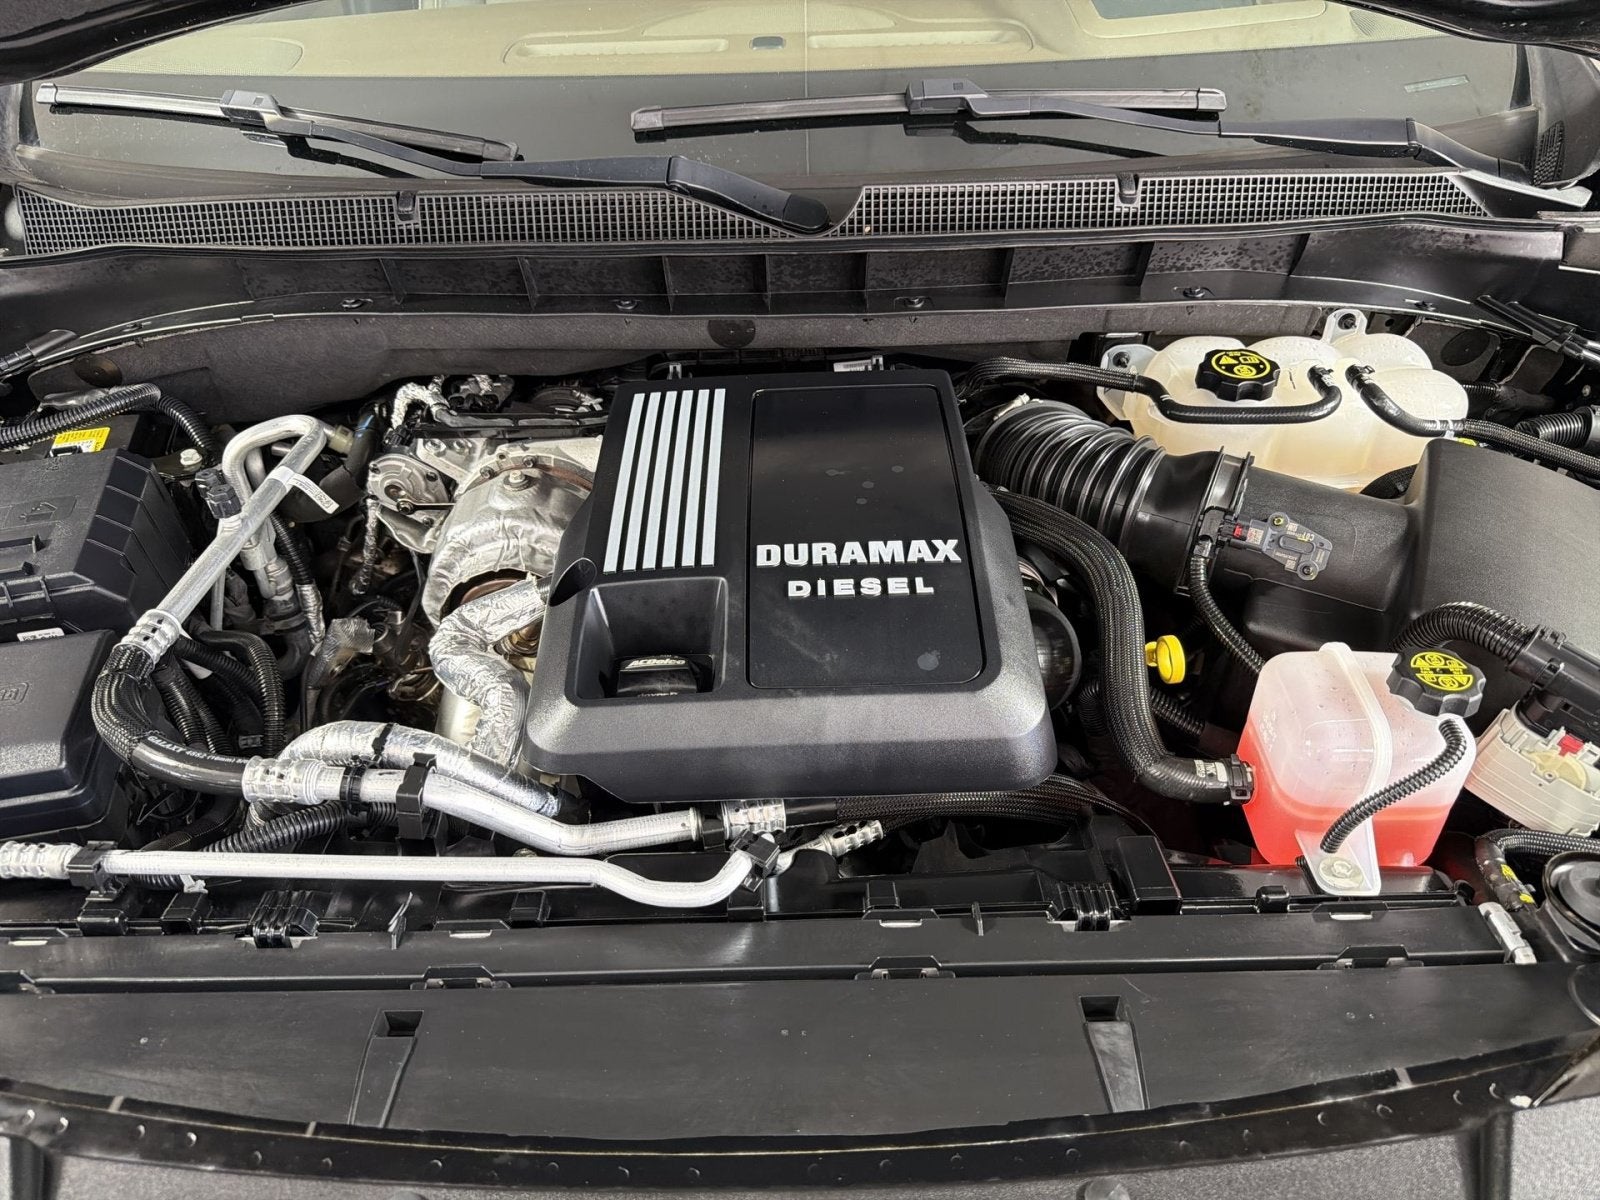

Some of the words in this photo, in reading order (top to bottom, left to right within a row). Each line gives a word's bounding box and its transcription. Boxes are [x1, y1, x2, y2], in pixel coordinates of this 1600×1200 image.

[756, 539, 961, 567] DURAMAX
[788, 576, 935, 599] DIESEL
[625, 658, 686, 669] ACDelco
[147, 735, 186, 753] GALAXY
